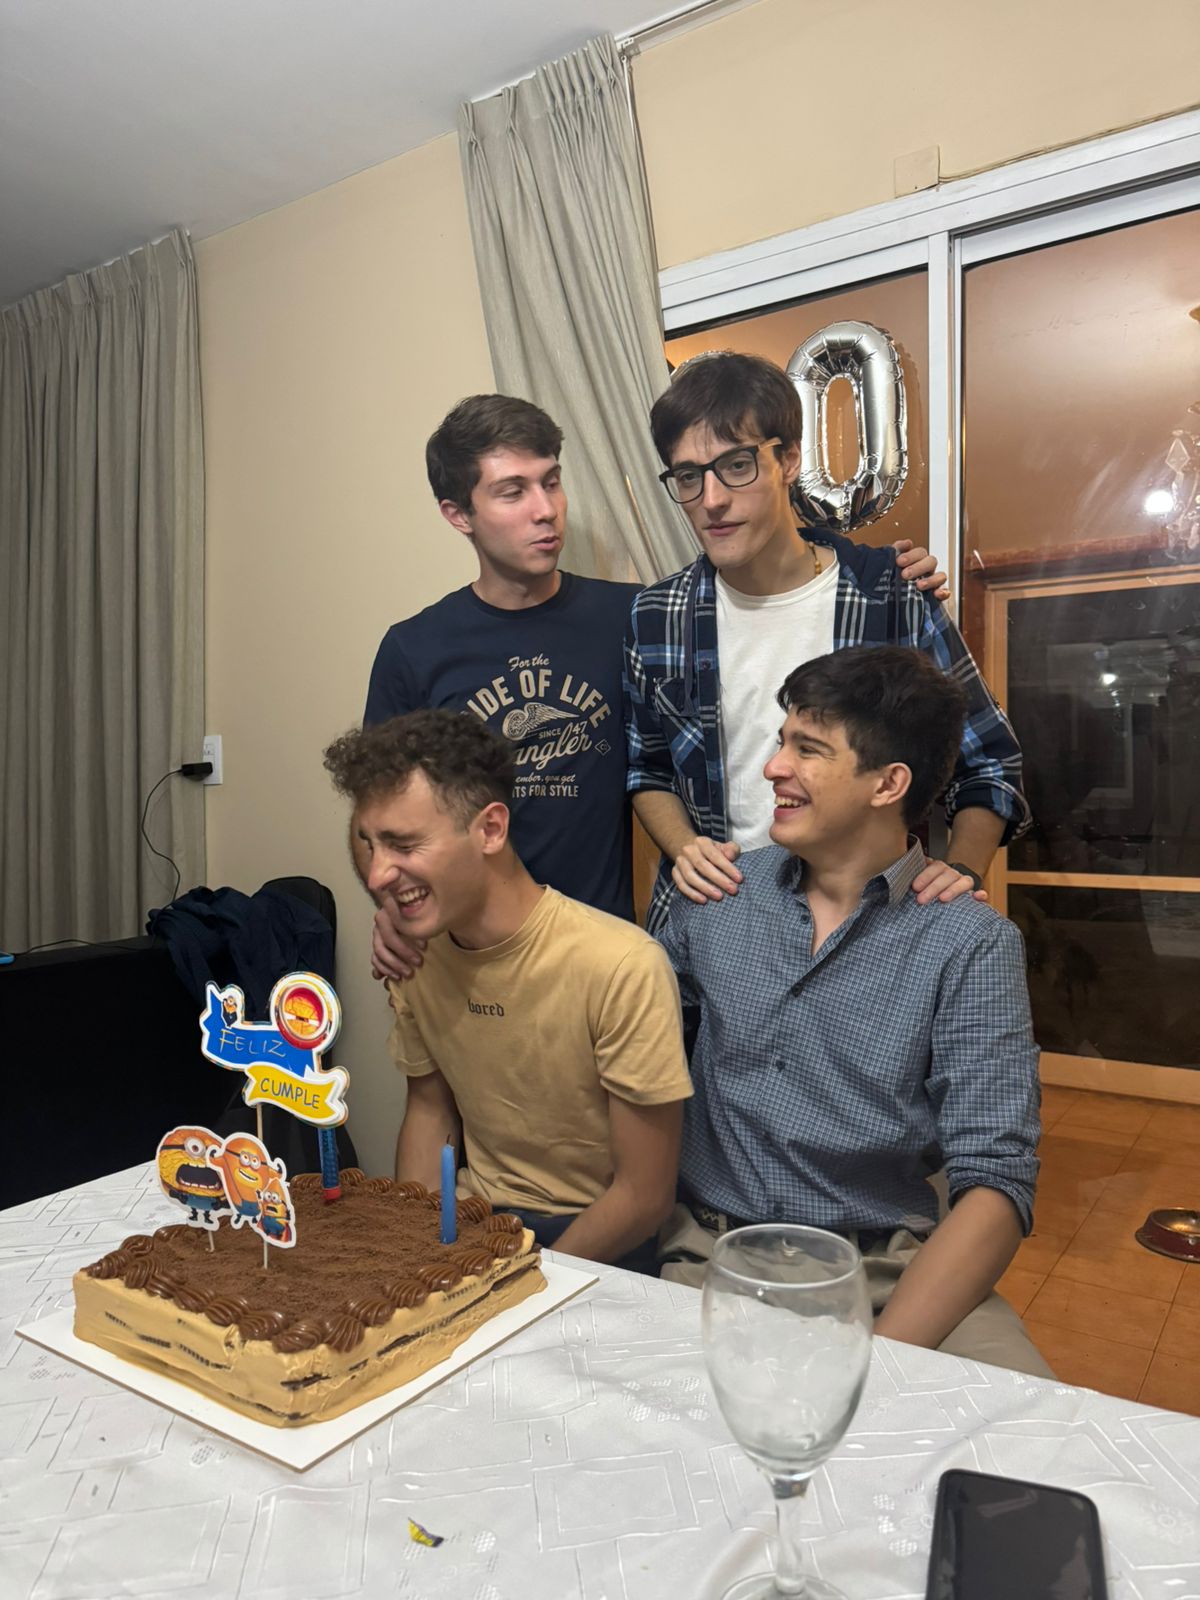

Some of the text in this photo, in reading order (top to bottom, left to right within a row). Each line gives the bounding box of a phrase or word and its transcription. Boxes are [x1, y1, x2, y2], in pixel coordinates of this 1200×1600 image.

[508, 653, 550, 671] For the
[460, 669, 612, 729] IDE OF LIFE
[539, 728, 562, 739] SINCE
[514, 772, 544, 783] ember,
[560, 774, 576, 785] get
[529, 785, 547, 797] FOR
[549, 784, 579, 797] STYLE
[219, 1028, 286, 1058] FELIZ
[260, 1078, 320, 1109] CUMPLE
